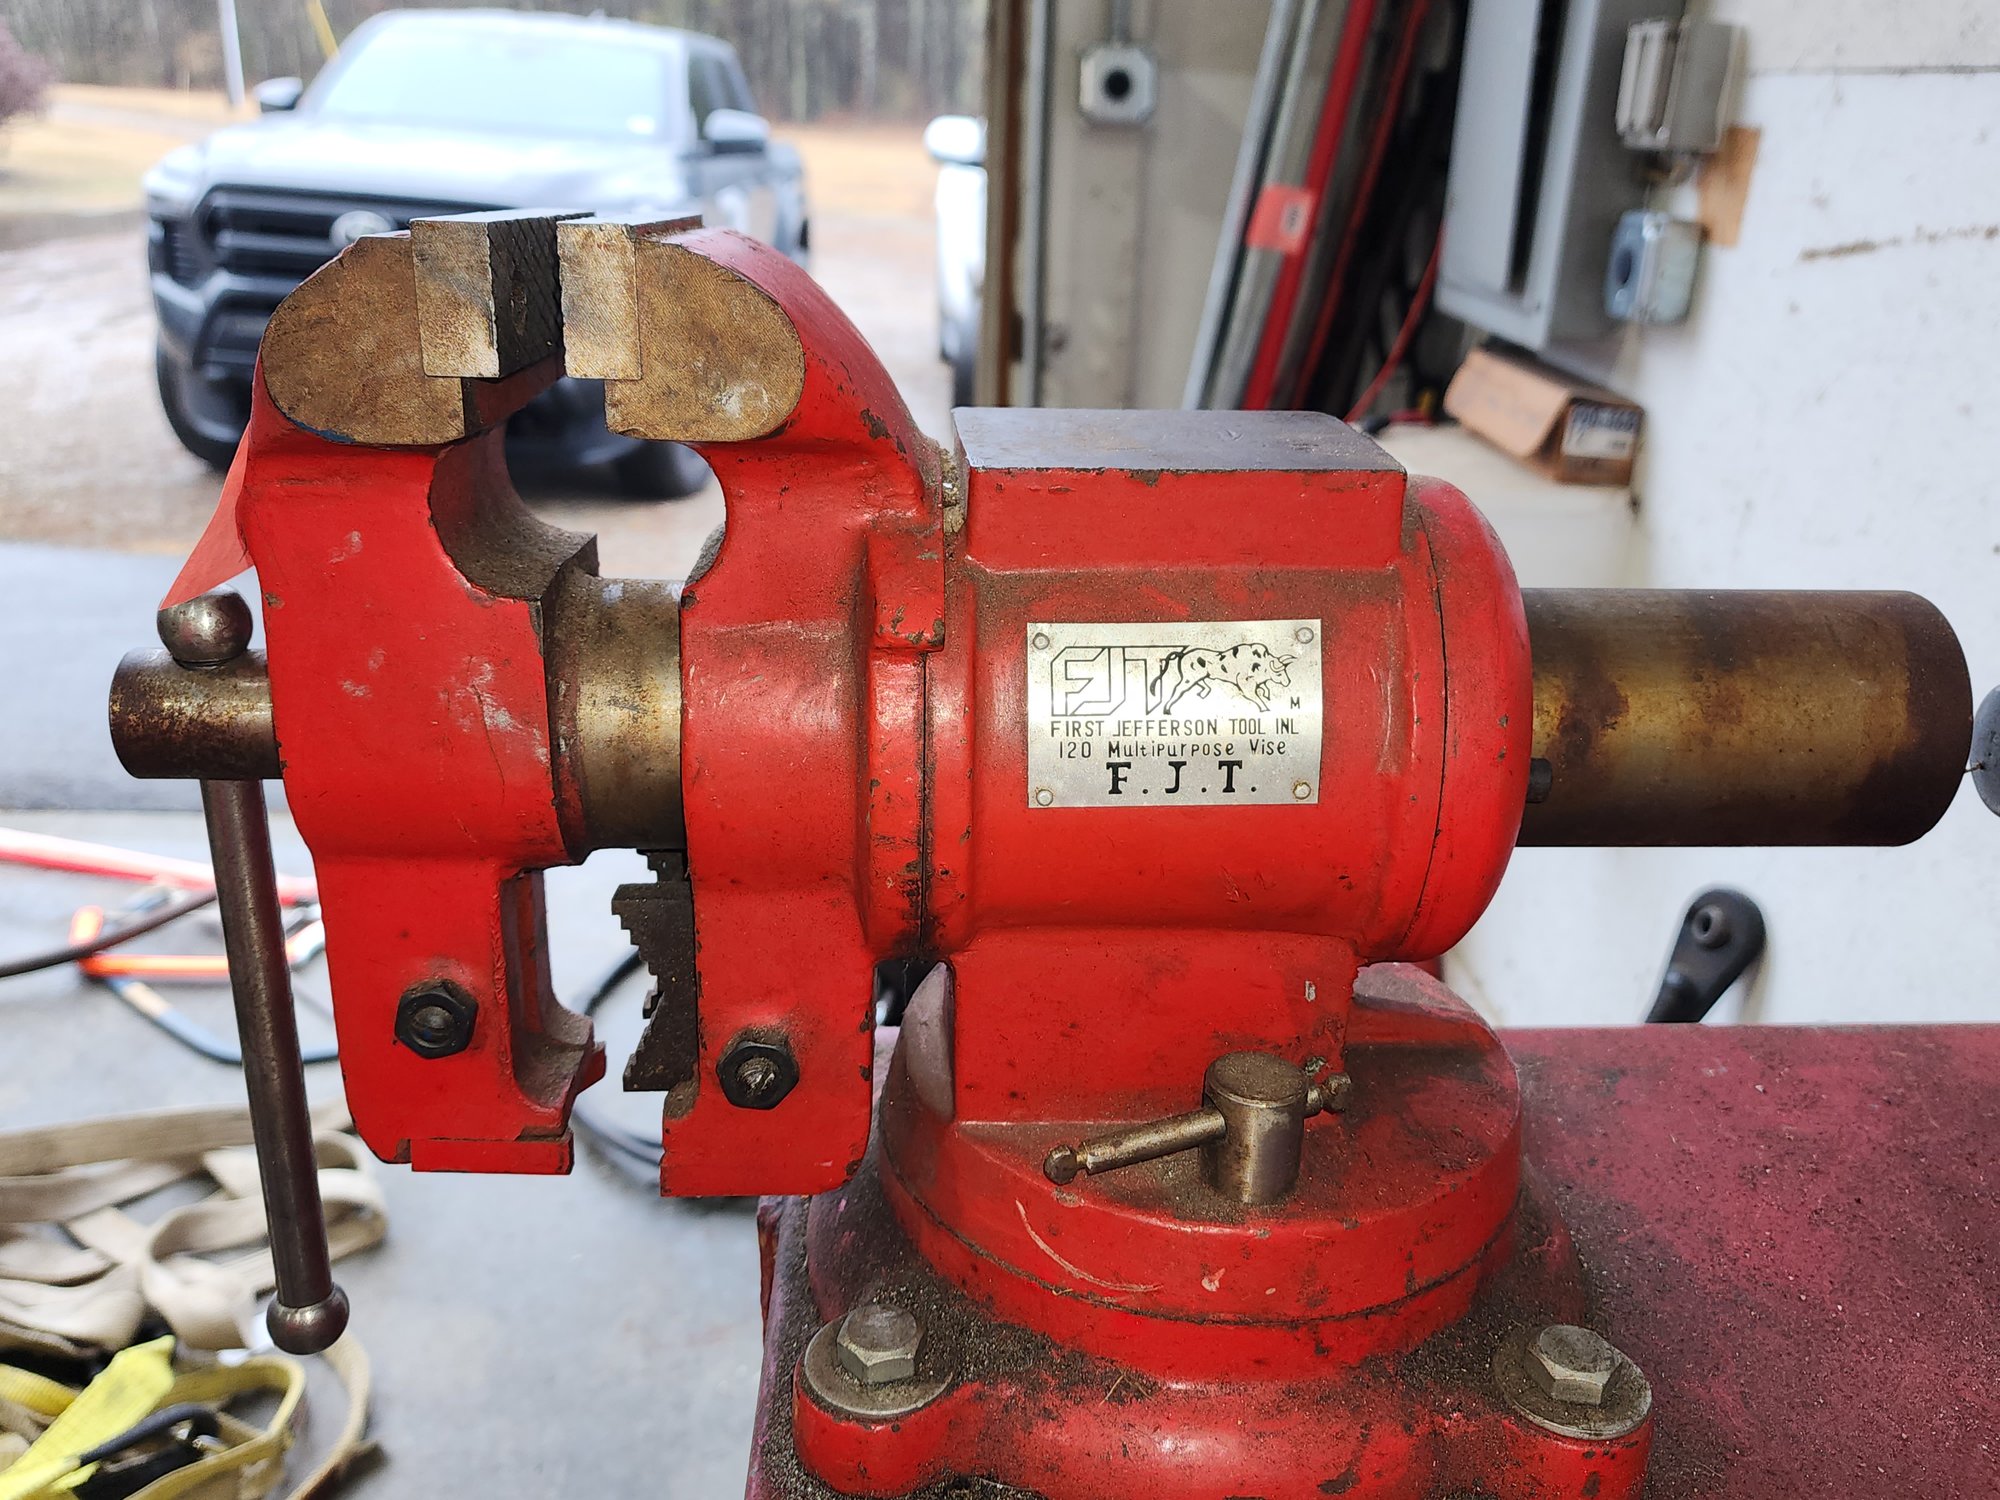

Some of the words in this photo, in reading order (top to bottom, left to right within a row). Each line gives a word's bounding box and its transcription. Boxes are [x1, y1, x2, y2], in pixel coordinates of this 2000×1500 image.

[1050, 645, 1189, 716] FJT
[1290, 696, 1300, 709] M
[1051, 720, 1105, 737] FIRST
[1112, 718, 1217, 737] JEFFERSON
[1228, 718, 1266, 735] TOOL
[1060, 741, 1091, 758] 120
[1108, 740, 1234, 758] Multipurpose
[1249, 738, 1286, 755] Vise
